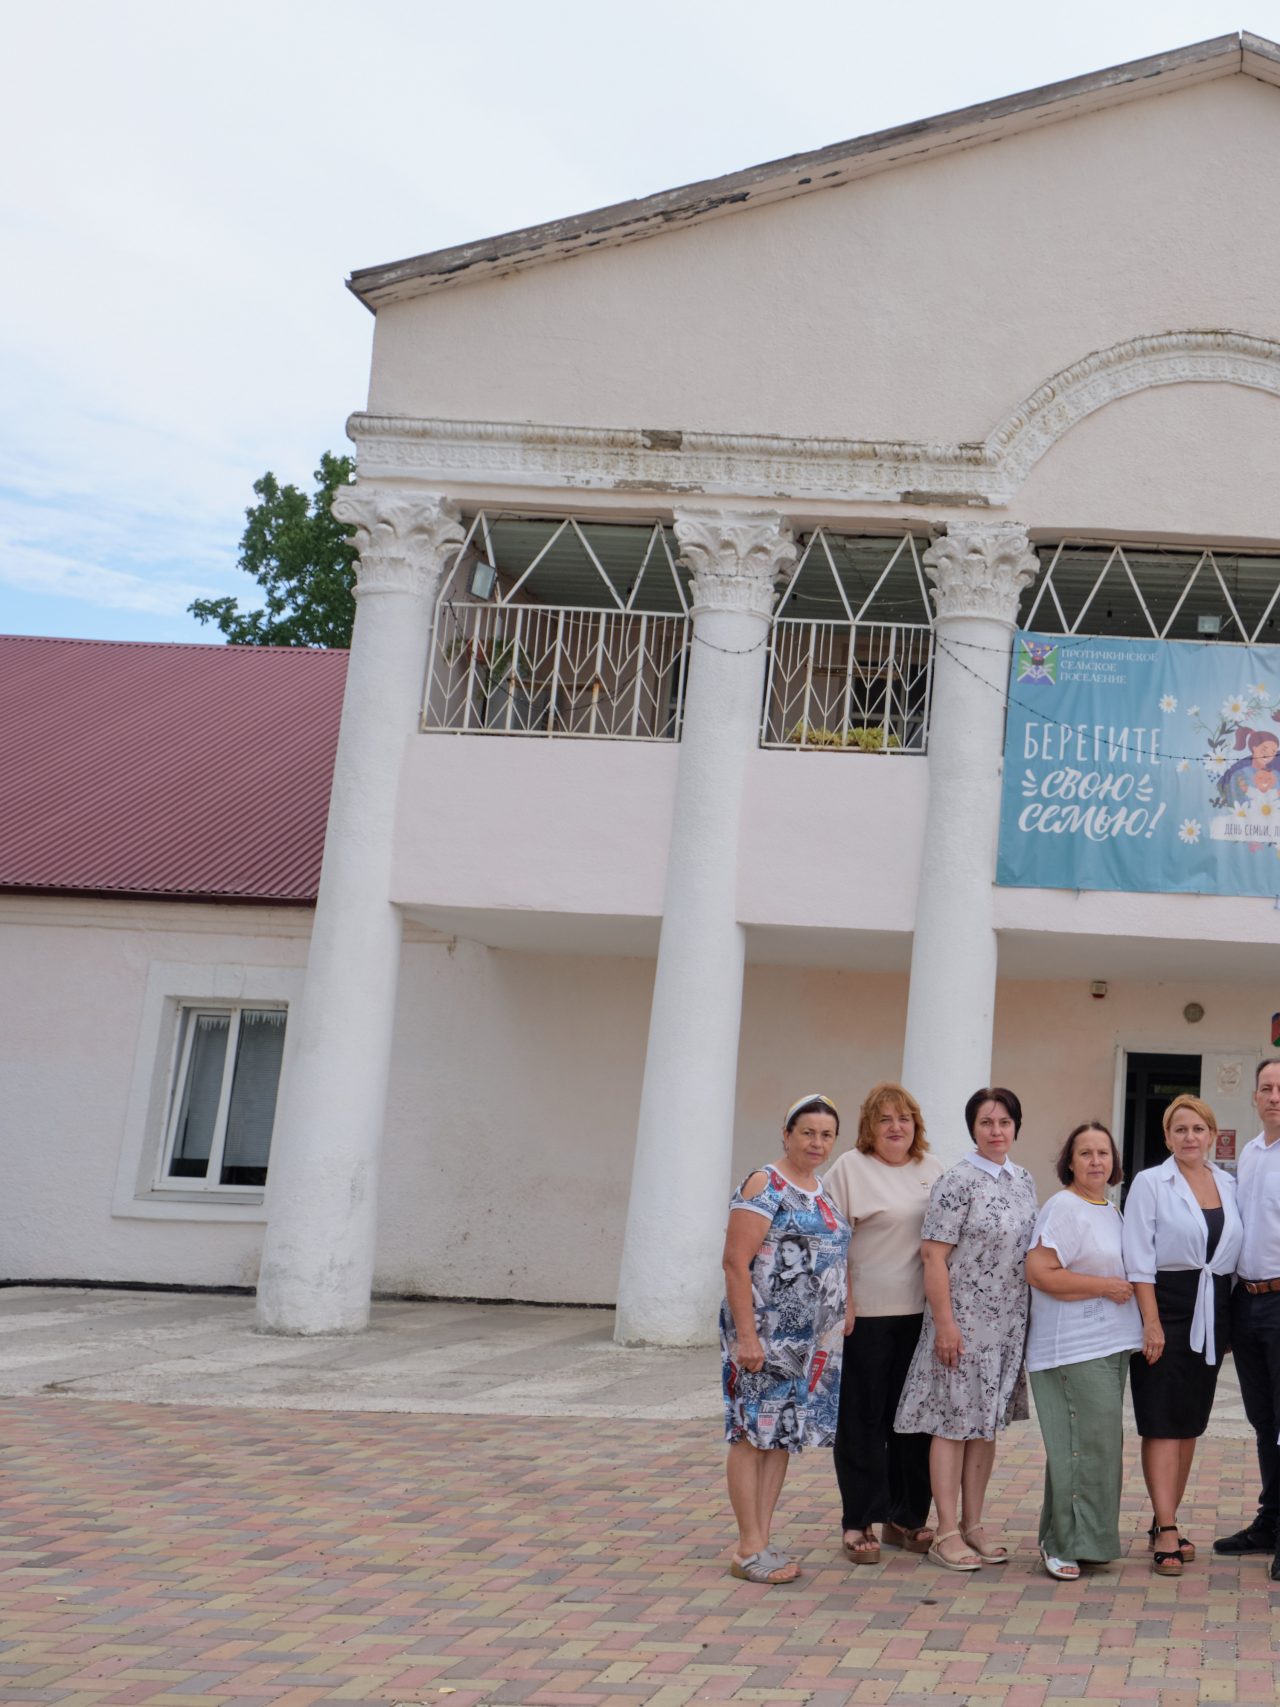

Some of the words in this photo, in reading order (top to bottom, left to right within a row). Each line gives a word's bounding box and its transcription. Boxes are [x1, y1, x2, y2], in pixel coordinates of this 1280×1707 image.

[1061, 649, 1159, 662] ПРОТИЧКИНСКОЕ
[1060, 660, 1117, 672] СЕЛЬСКОЕ
[1060, 672, 1127, 684] ПОСЕЛЕНИЕ
[1023, 722, 1161, 765] БЕРЕГИТЕ
[1224, 823, 1243, 836] ДЕНЬ
[1244, 824, 1272, 838] СЕМЬИ,
